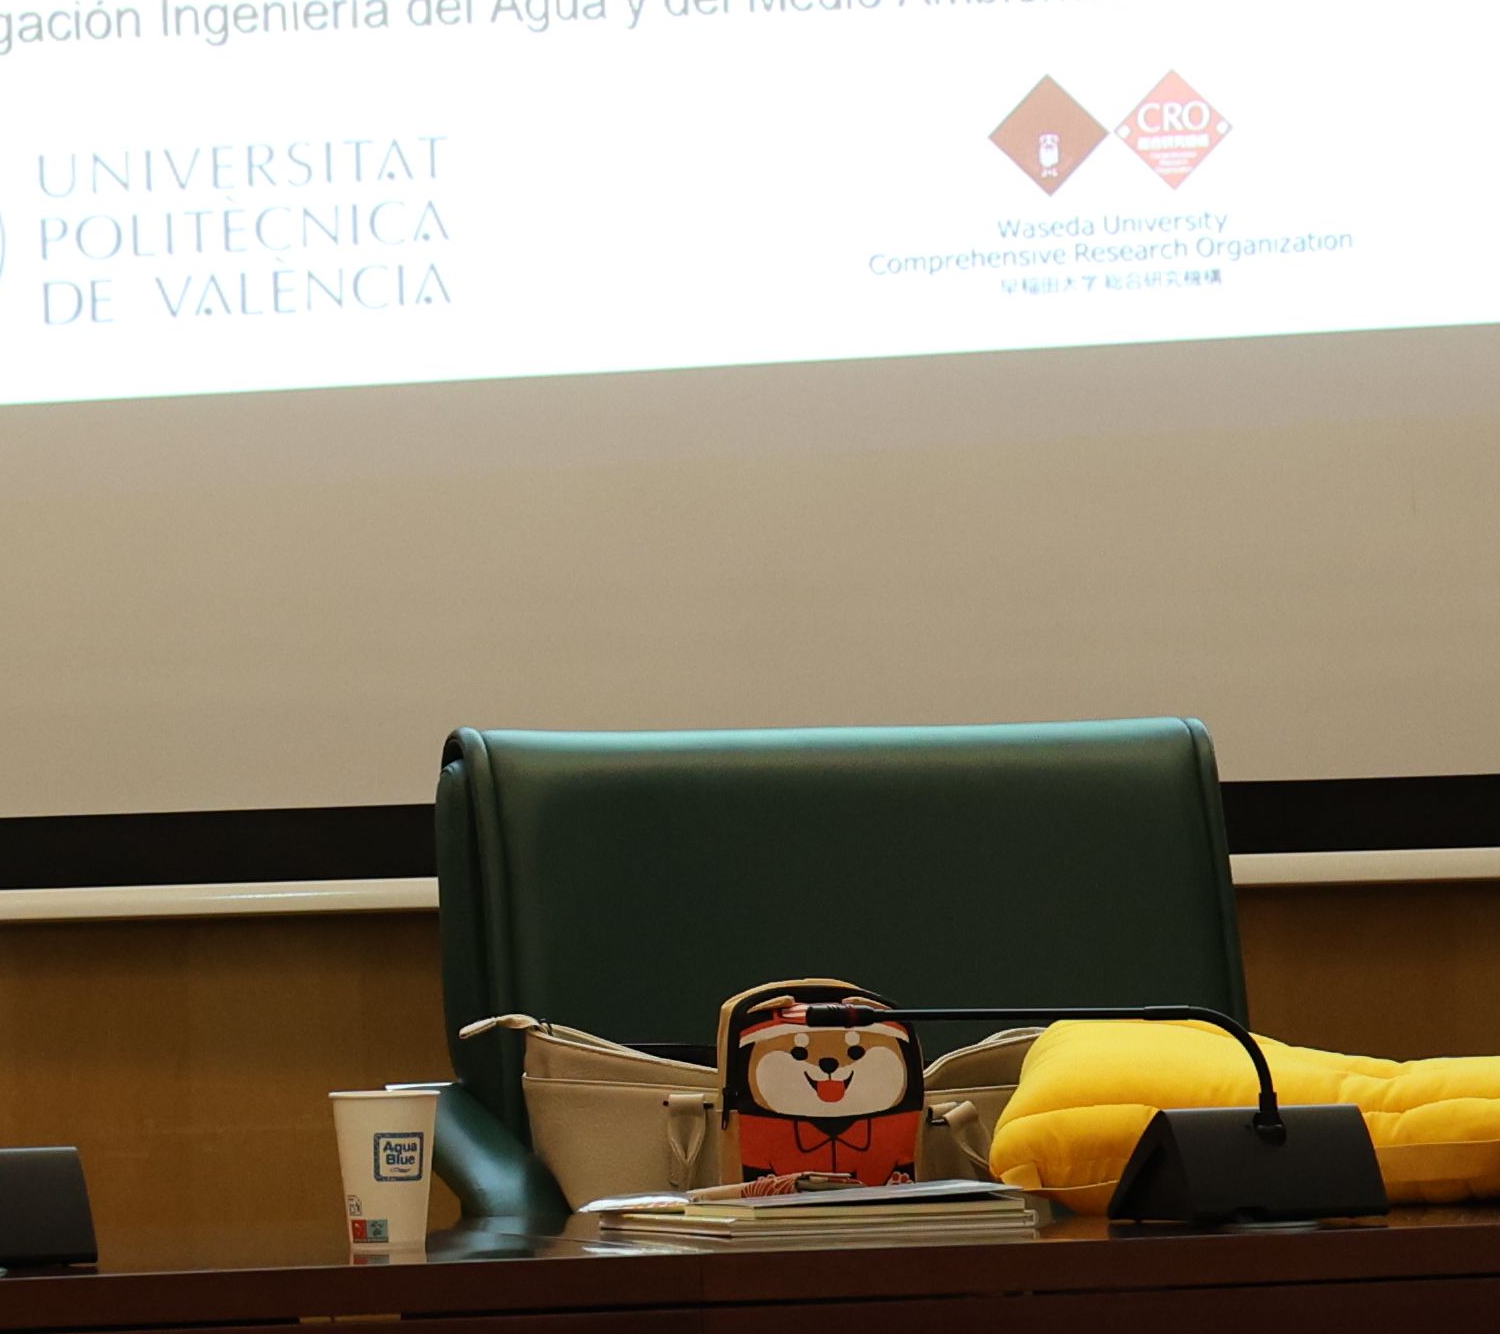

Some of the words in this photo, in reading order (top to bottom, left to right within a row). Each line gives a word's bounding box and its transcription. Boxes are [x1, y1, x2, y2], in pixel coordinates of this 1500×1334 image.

[1136, 100, 1212, 133] CRO
[38, 136, 447, 198] UNIVERSITAT
[40, 196, 449, 262] POLITÈCNICA
[997, 216, 1095, 239] Waseda
[1104, 211, 1227, 235] University
[869, 248, 1066, 275] Comprehensive
[1075, 239, 1188, 263] Research
[1195, 232, 1353, 261] Organization
[42, 279, 114, 325] DE
[155, 262, 451, 318] VALÈNCIA
[383, 1140, 418, 1156] Aqua
[386, 1154, 416, 1166] Blue
